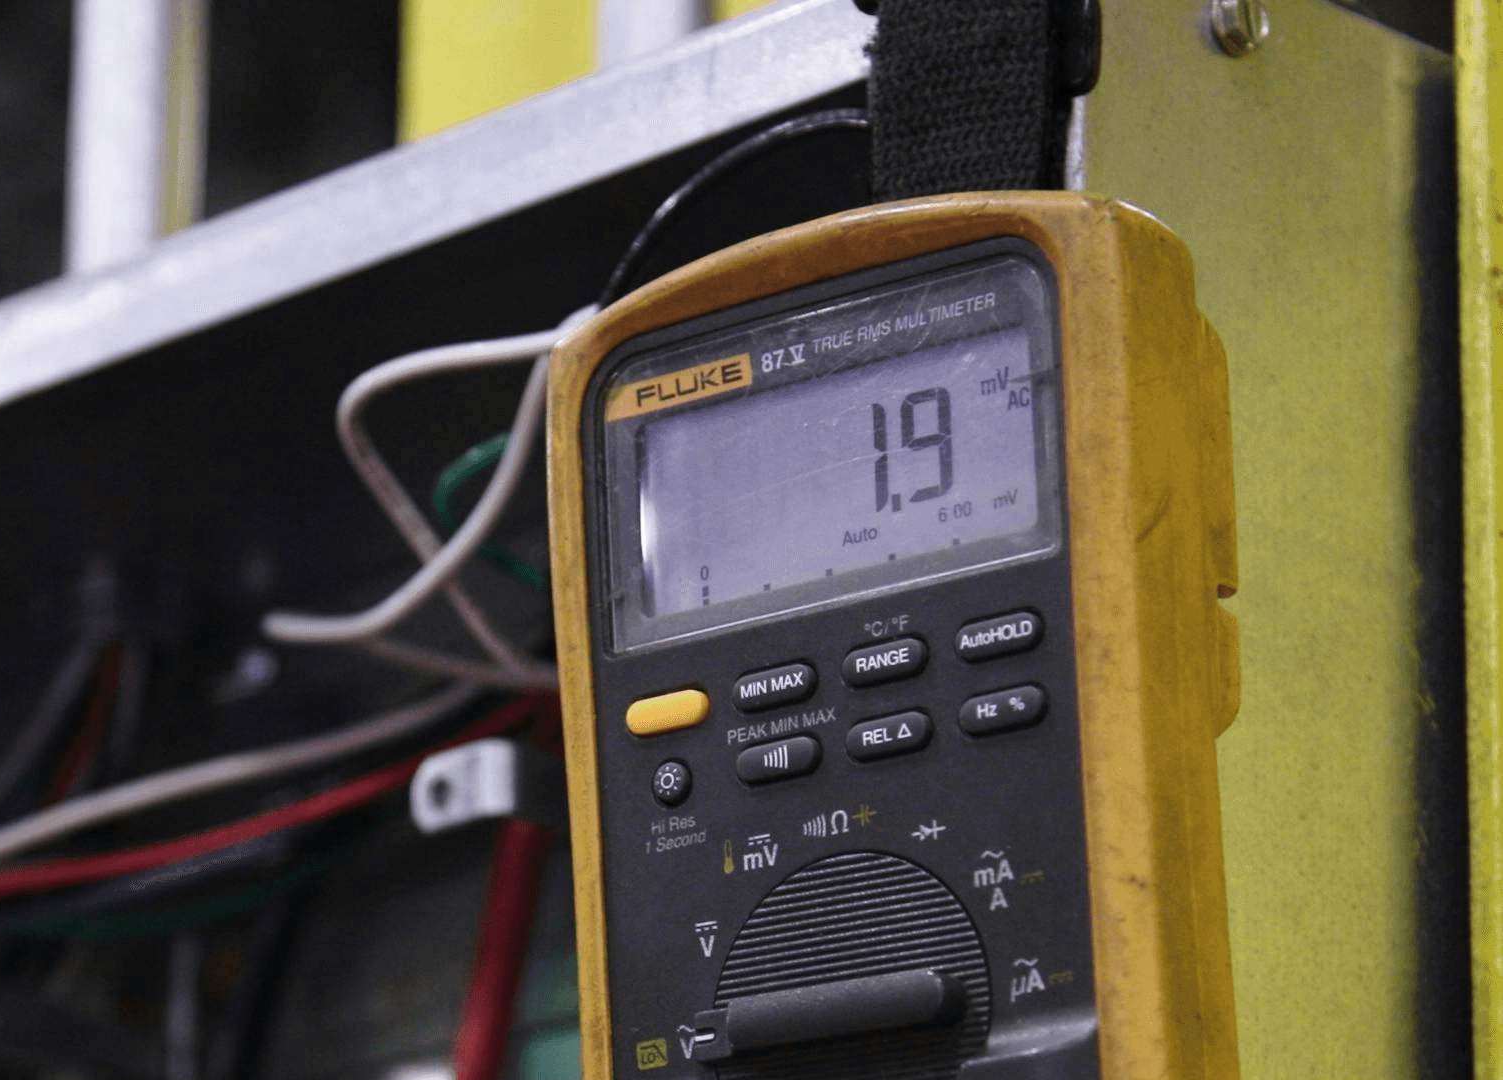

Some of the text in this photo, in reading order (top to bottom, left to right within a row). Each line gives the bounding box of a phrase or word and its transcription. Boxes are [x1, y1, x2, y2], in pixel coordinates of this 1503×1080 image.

[634, 360, 744, 408] FLUKE
[812, 330, 853, 354] TRUE
[857, 319, 891, 342] RMS
[895, 292, 996, 333] MULTIMETER
[980, 366, 1010, 396] mV
[1007, 386, 1031, 411] AC
[870, 385, 953, 513] 1.9
[992, 488, 1019, 510] mV
[841, 526, 879, 548] Auto
[959, 620, 1033, 650] AutoHOLD
[855, 648, 910, 674] RANGE
[740, 672, 804, 700] MIN MAX
[976, 703, 998, 719] Hz
[727, 706, 837, 745] PEAK MIN MAX
[862, 728, 893, 746] REL
[651, 815, 696, 835] Hi Res
[655, 828, 707, 852] Second
[743, 843, 778, 871] mV
[973, 858, 1015, 888] mA
[989, 887, 1009, 911] A
[699, 935, 715, 957] V
